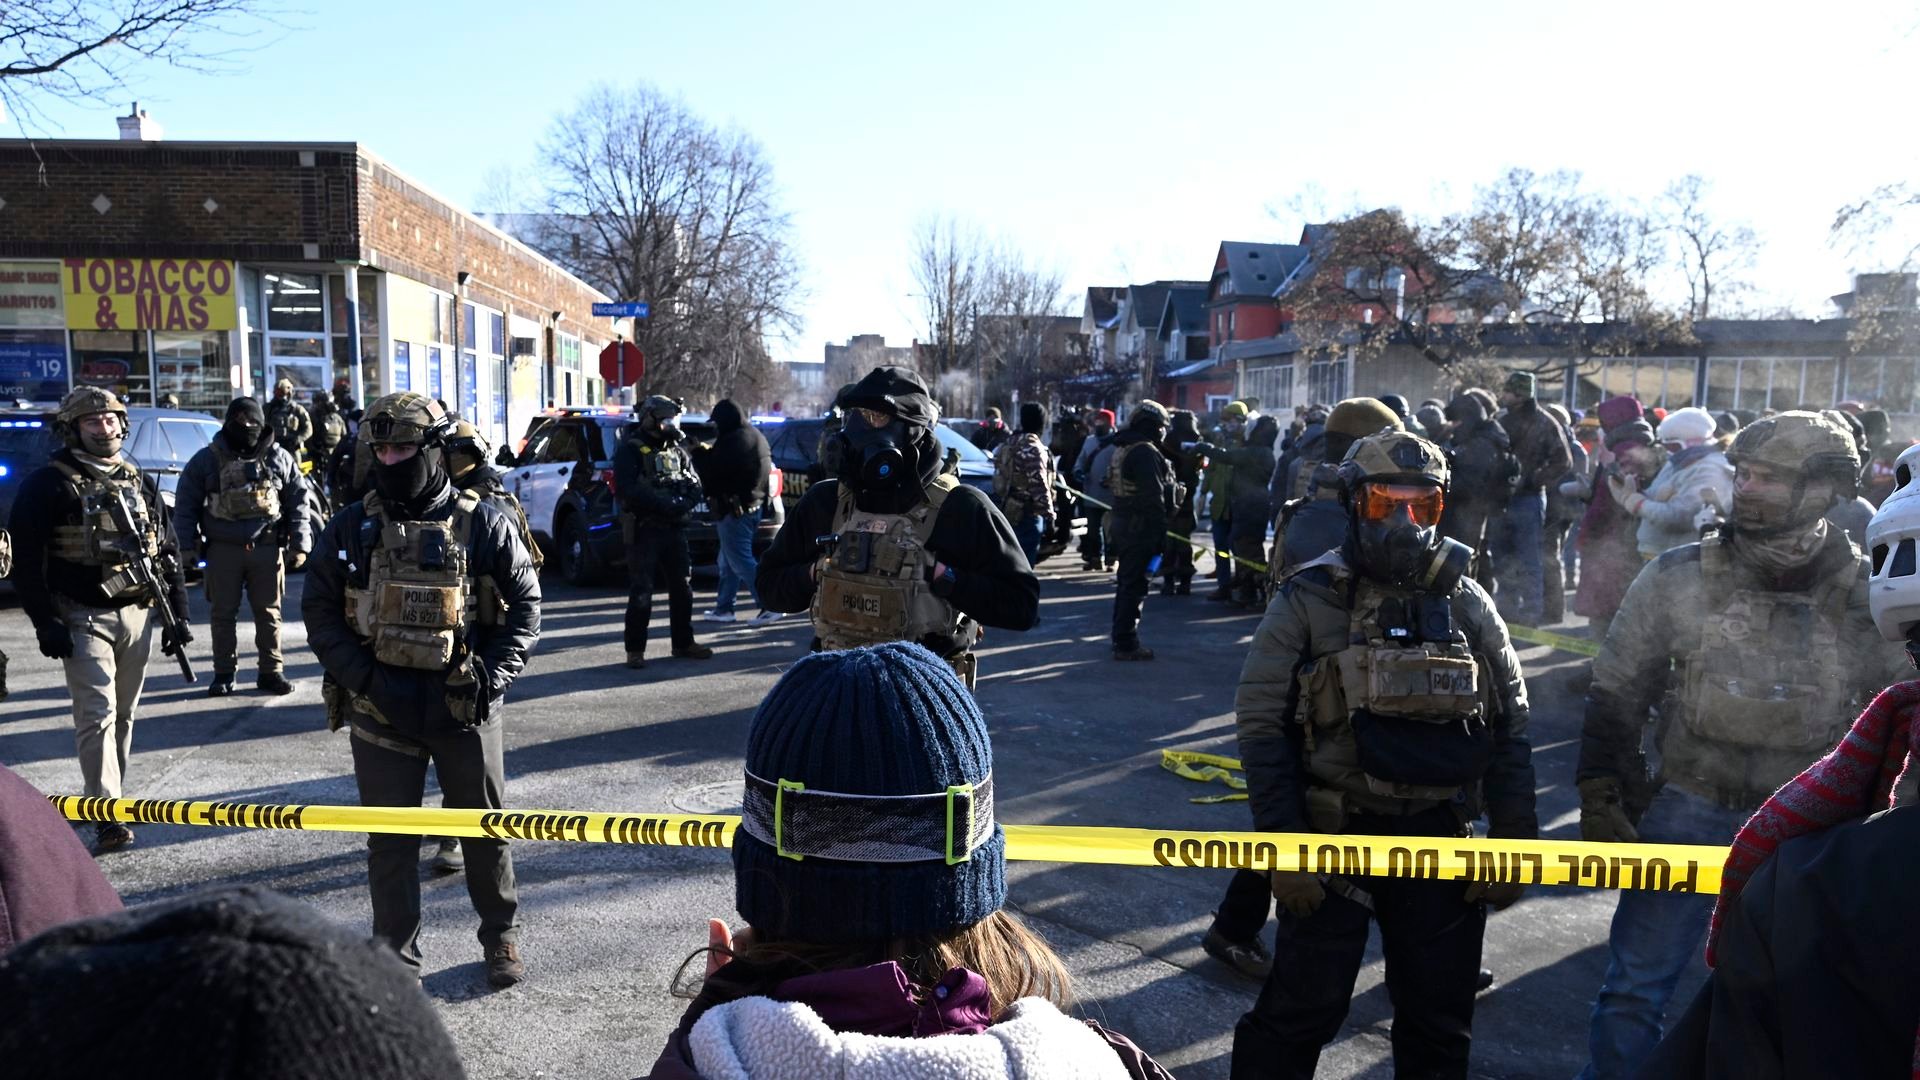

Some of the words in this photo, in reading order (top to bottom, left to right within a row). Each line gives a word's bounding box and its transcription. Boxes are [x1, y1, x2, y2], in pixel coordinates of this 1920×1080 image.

[64, 258, 231, 295] TOBACCO
[95, 295, 119, 330] &
[135, 294, 209, 330] MAS
[593, 304, 627, 315] Nicollet
[634, 305, 647, 315] Av
[404, 590, 439, 604] POLICE
[843, 594, 879, 613] POLICE
[480, 812, 589, 842] CROSS
[603, 817, 669, 845] NOT
[679, 820, 726, 847] DO
[1153, 837, 1277, 871] CROSS
[1299, 843, 1371, 876] NOT
[1388, 846, 1439, 880] DO
[1454, 850, 1542, 884] LINE
[1558, 854, 1698, 893] POLICE
